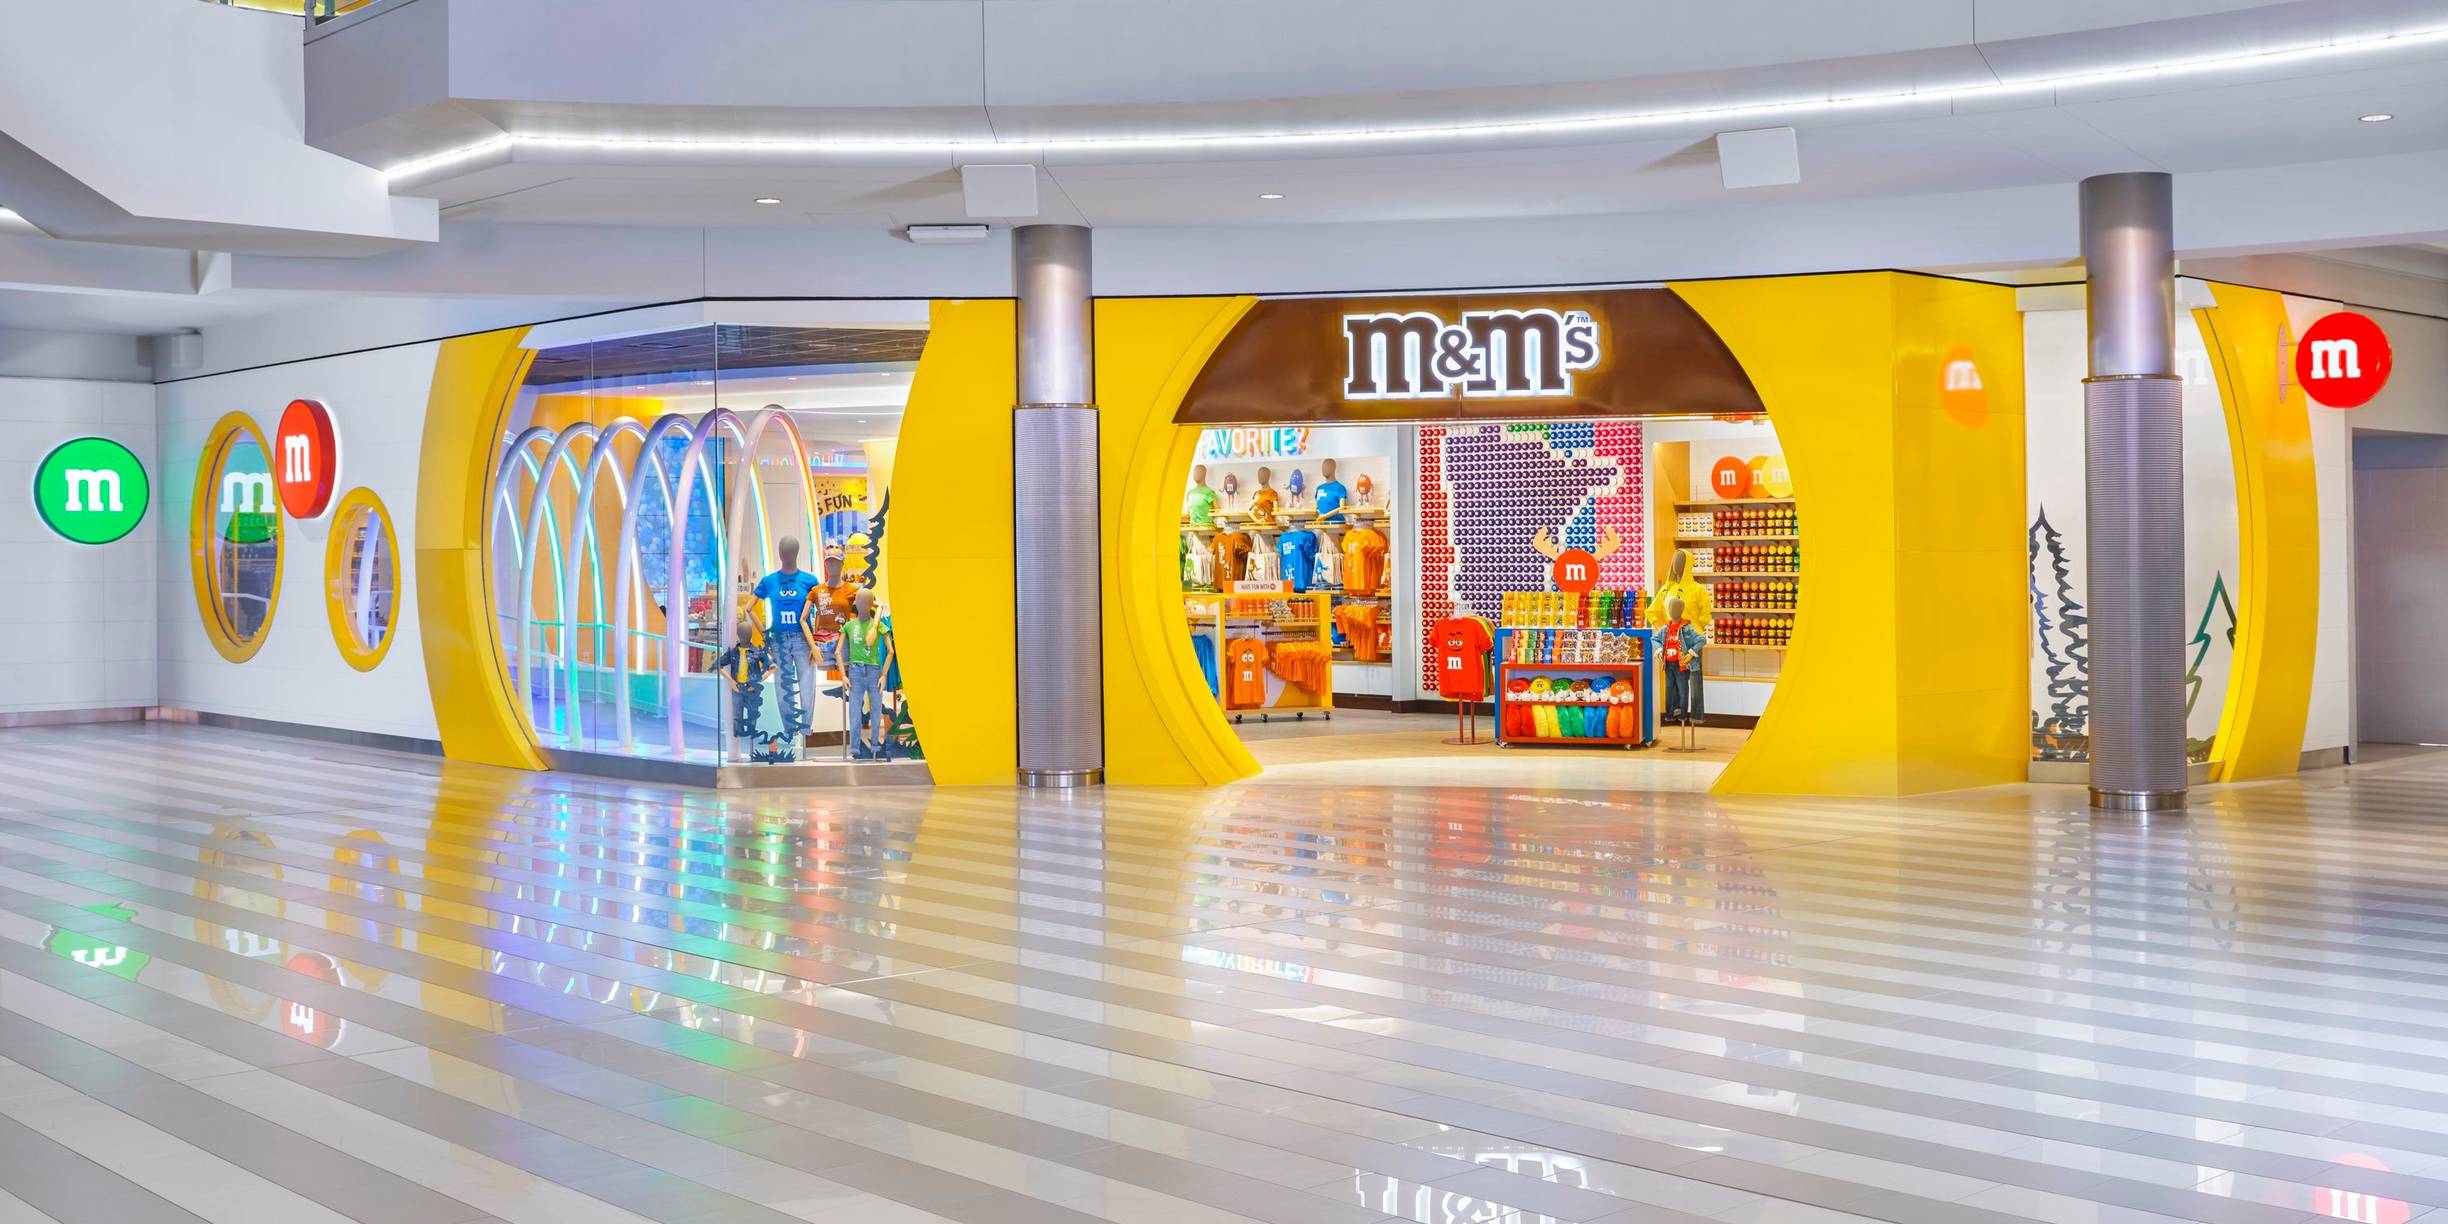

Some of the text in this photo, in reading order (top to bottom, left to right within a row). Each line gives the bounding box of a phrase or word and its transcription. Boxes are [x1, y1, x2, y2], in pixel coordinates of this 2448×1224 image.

[2311, 339, 2361, 379] m
[285, 434, 311, 483] m
[1720, 470, 1736, 486] m
[65, 469, 123, 511] m
[824, 494, 852, 511] FUN
[1565, 564, 1587, 581] m
[780, 610, 797, 624] m
[1447, 656, 1463, 670] m
[1243, 670, 1253, 681] m
